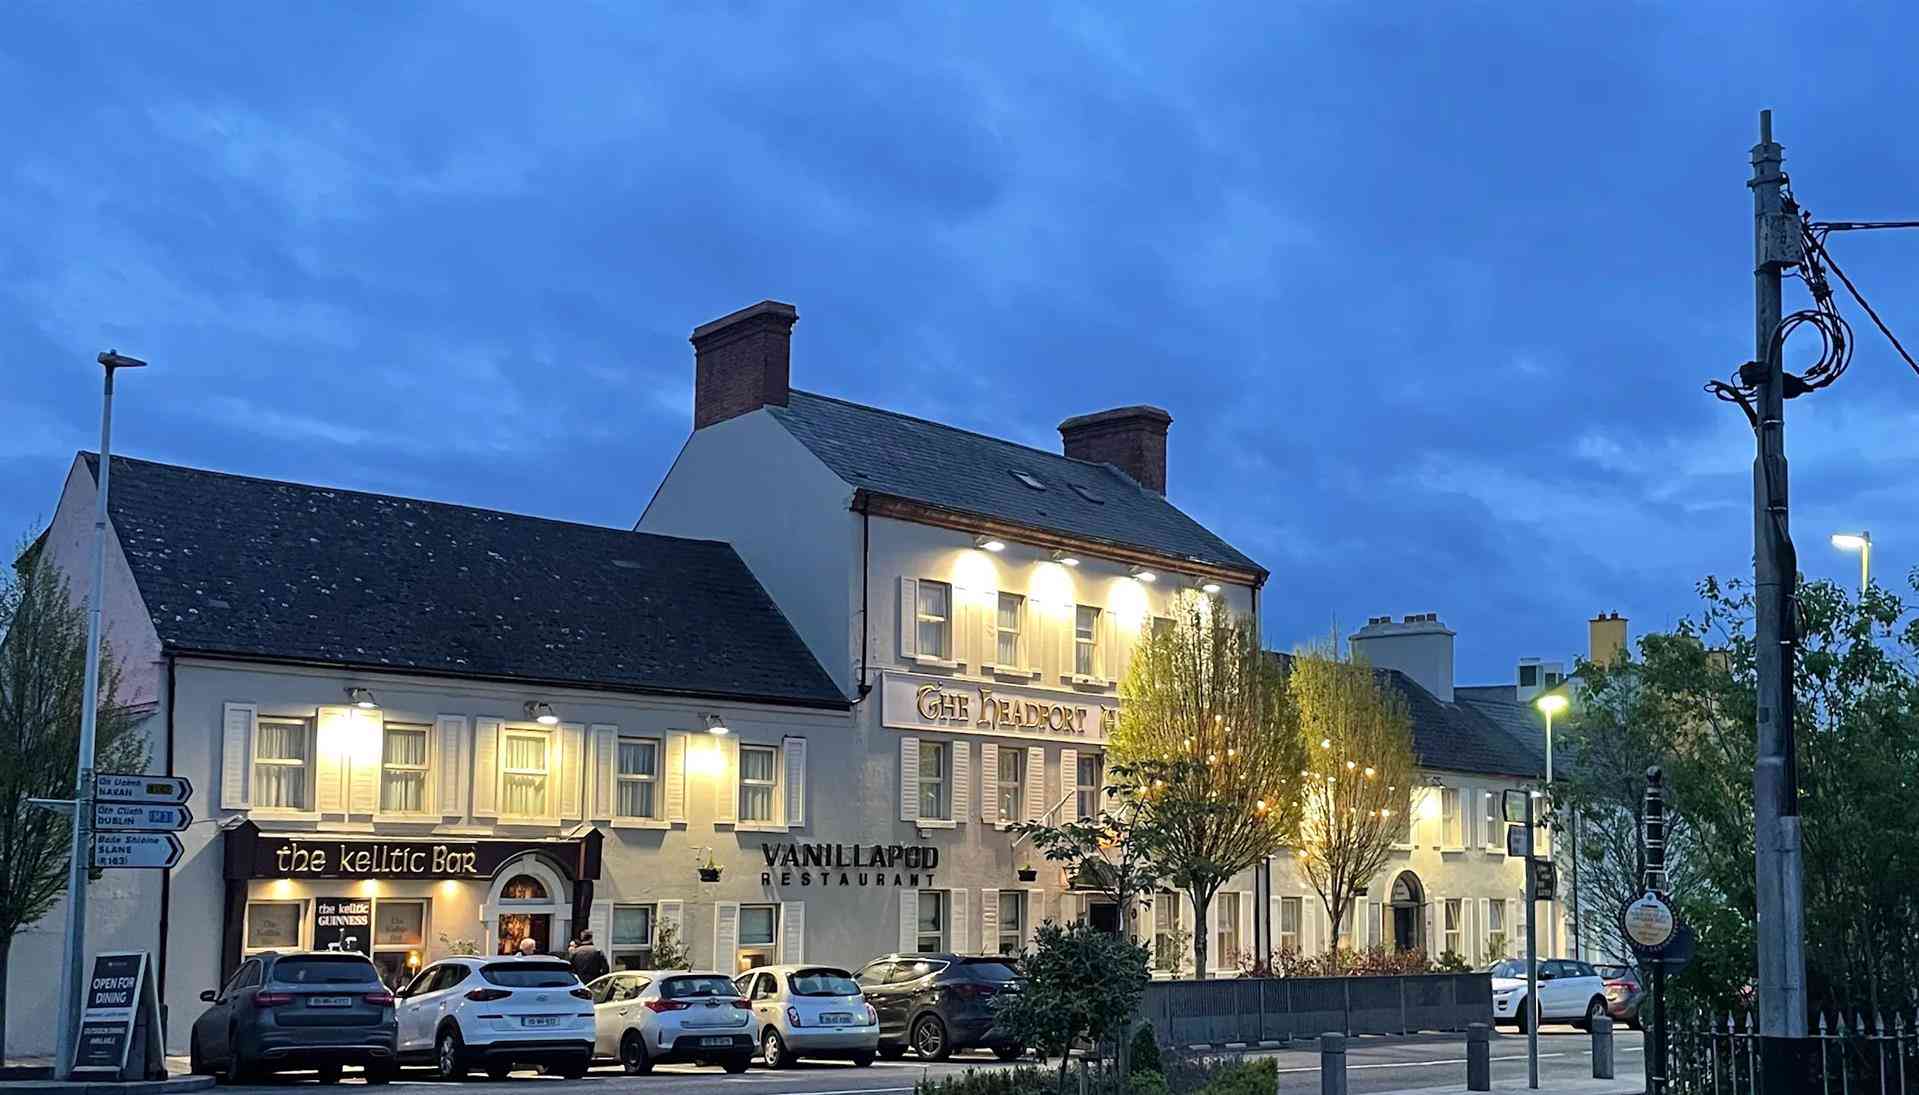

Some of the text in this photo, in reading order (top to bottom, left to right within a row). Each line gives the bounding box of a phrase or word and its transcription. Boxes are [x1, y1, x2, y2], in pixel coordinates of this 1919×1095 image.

[916, 682, 969, 722] THE
[976, 687, 1087, 733] HEADFORT
[97, 815, 135, 826] DUBLIN
[98, 846, 132, 855] SLANE
[276, 843, 326, 872] the
[339, 844, 426, 873] kelltic
[761, 872, 937, 887] RESTAURANT
[318, 915, 369, 926] GUINNESS
[93, 977, 135, 990] OPEN FOR
[95, 992, 127, 1004] DINING
